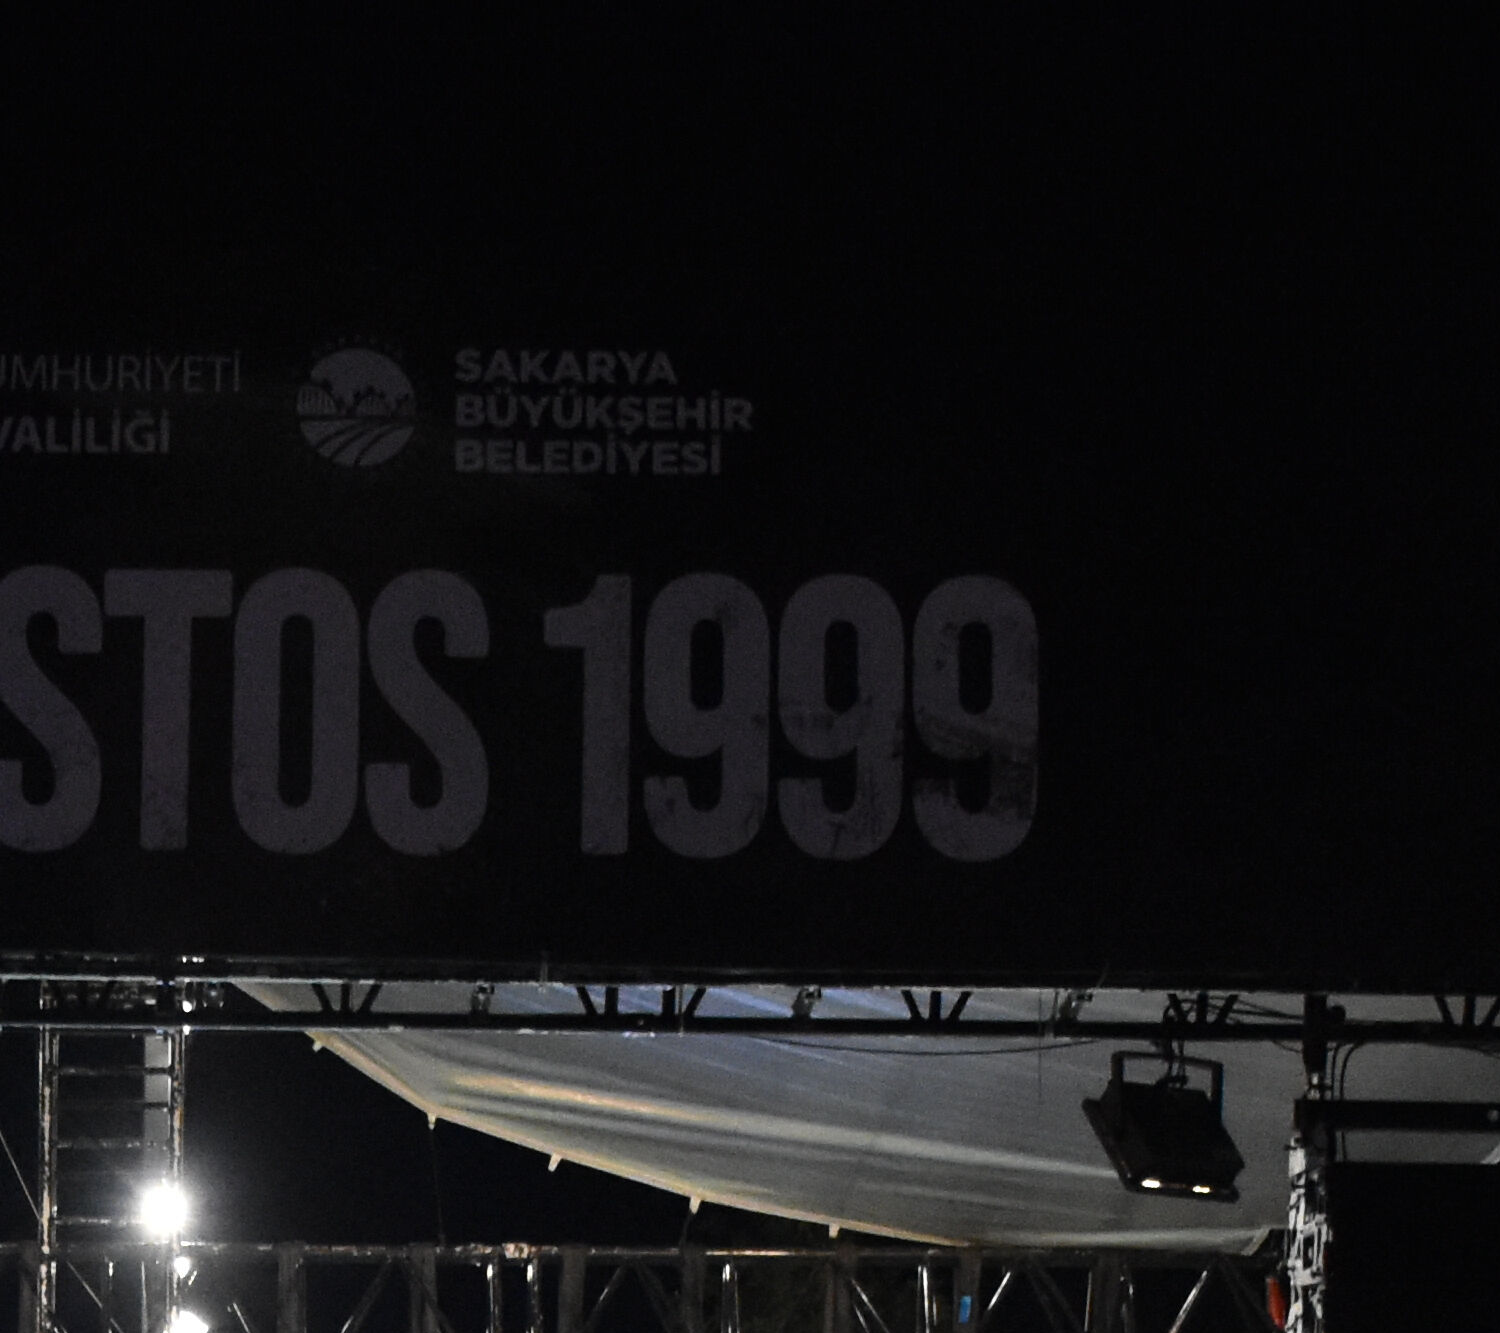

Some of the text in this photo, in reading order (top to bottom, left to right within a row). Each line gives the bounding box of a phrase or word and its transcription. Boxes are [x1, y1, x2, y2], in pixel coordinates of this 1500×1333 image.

[453, 346, 679, 385] SAKARYA
[453, 388, 755, 436] BÜYÜKŞEHİR
[453, 432, 722, 476] BELEDİYESİ
[543, 571, 1040, 862] 1999
